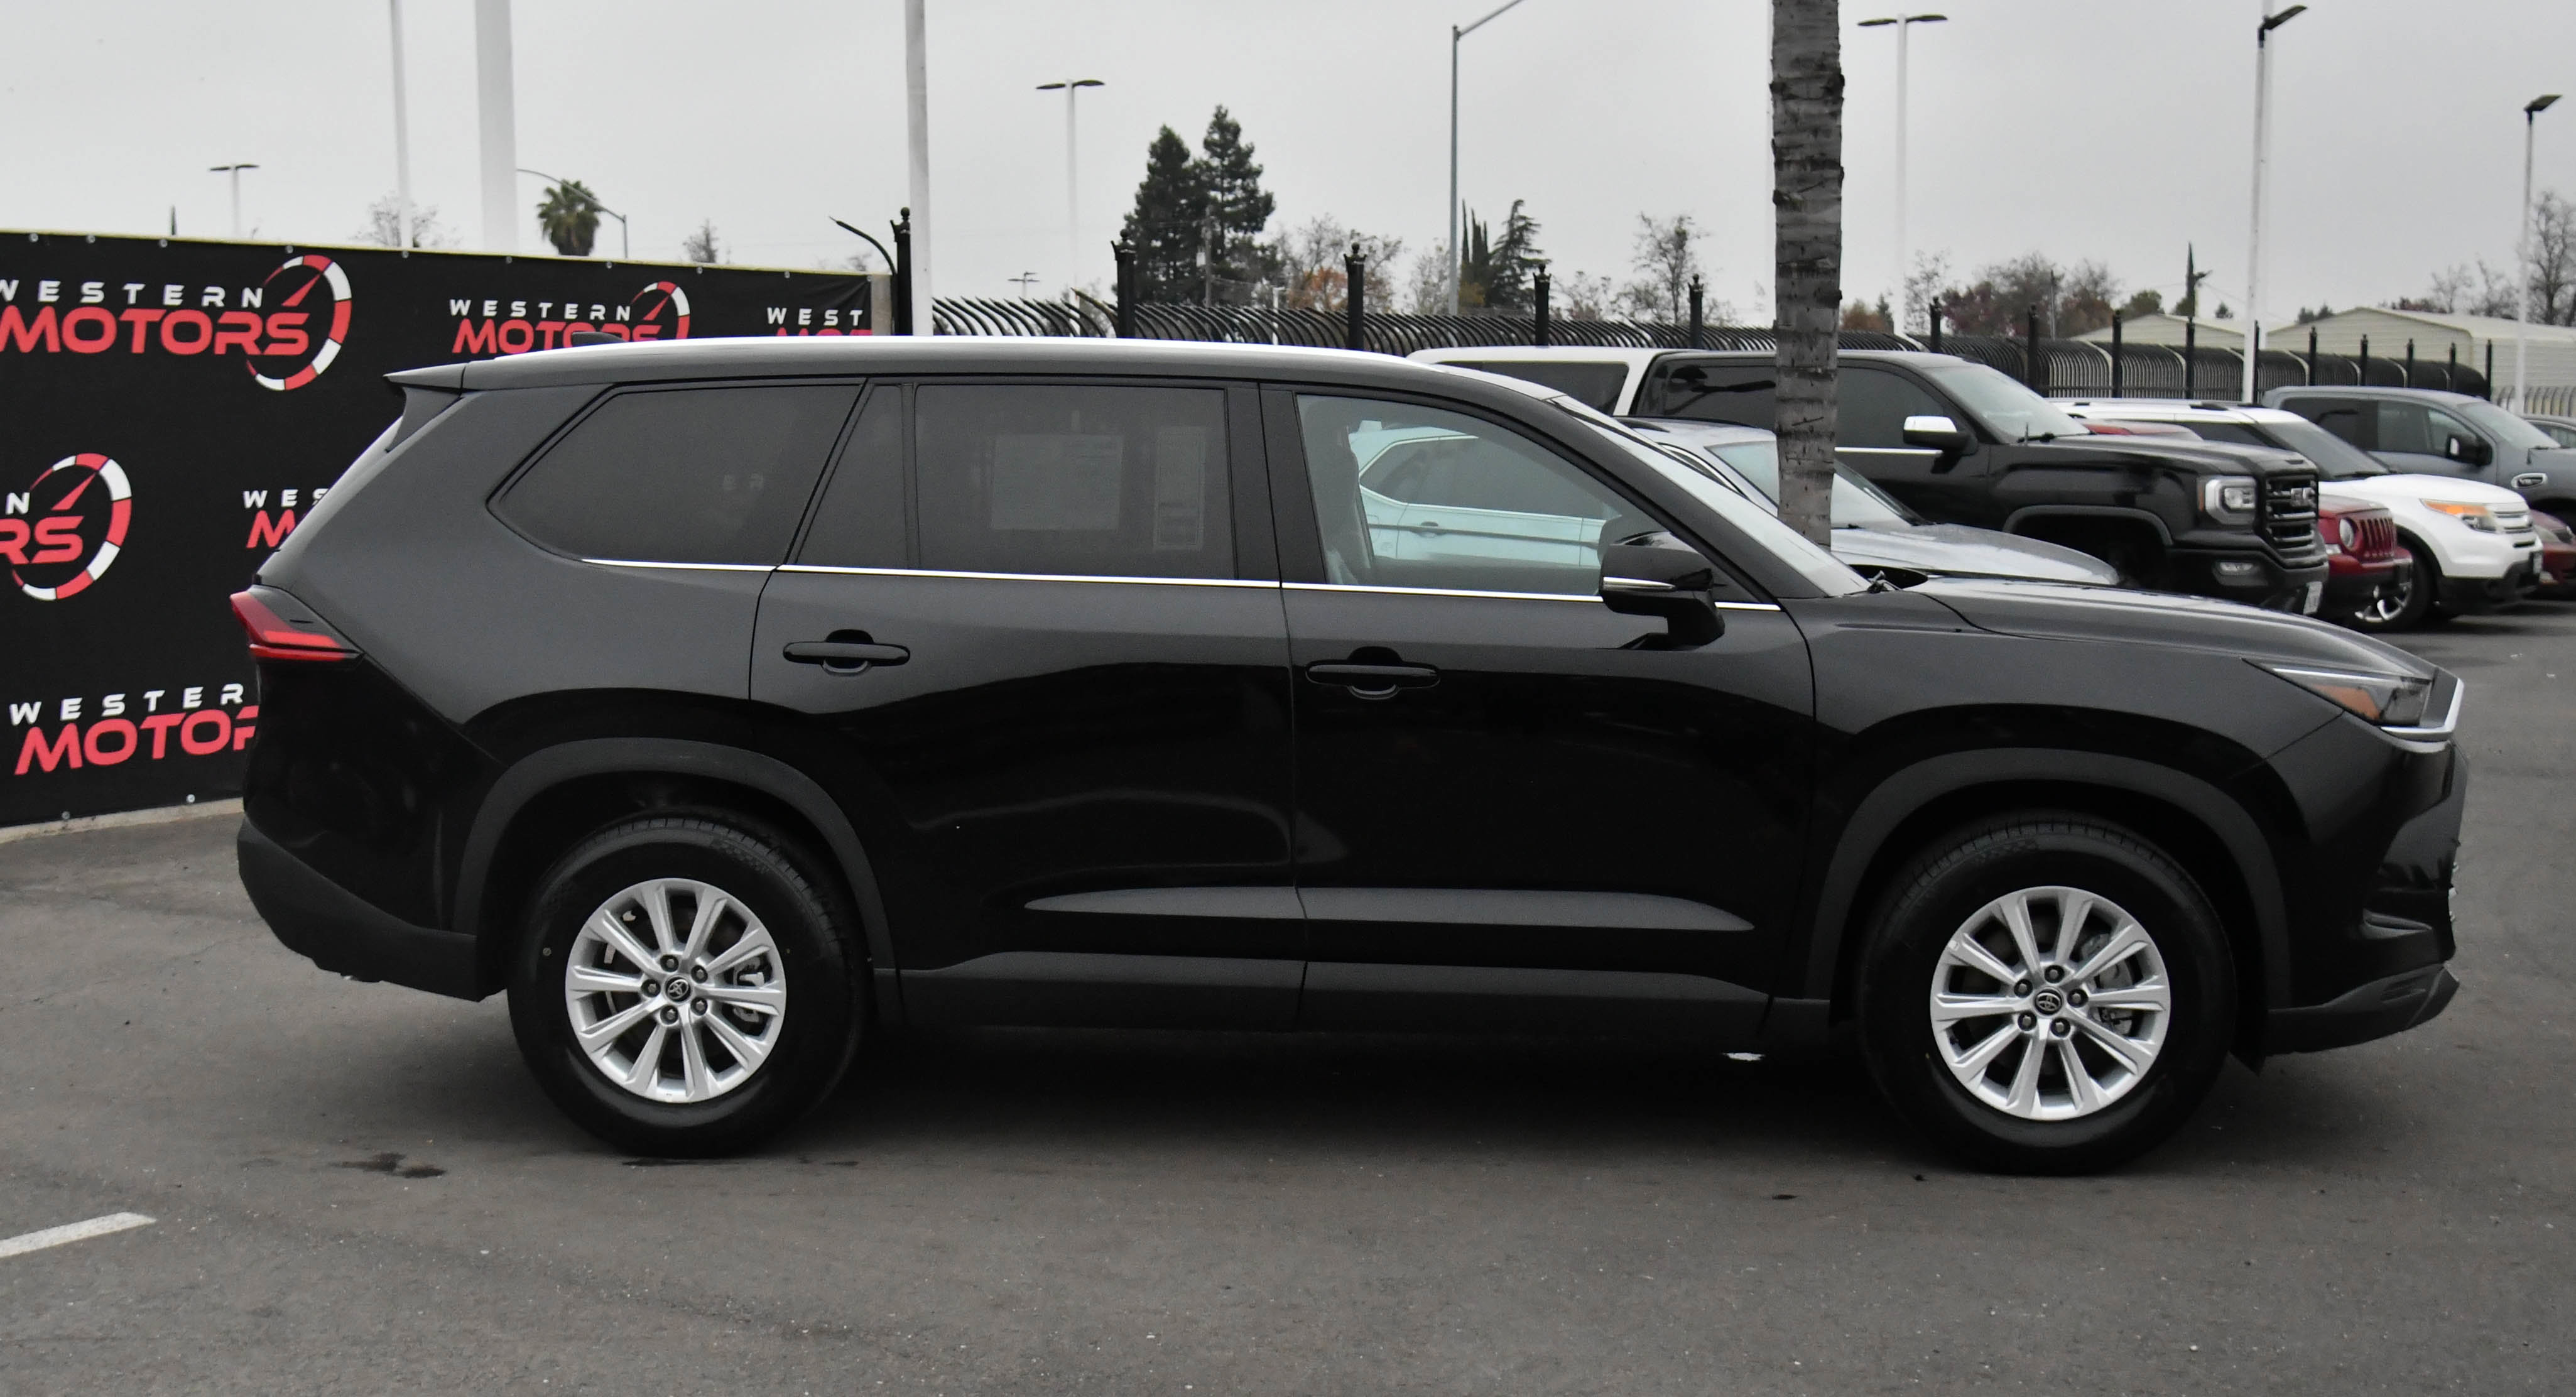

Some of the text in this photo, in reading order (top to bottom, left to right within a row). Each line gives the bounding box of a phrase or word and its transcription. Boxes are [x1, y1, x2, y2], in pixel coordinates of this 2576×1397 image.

[0, 280, 263, 307] WESTERN
[450, 300, 631, 321] WESTERN
[767, 307, 863, 326] WEST
[0, 305, 310, 355] MOTORS
[9, 683, 244, 726] WESTER
